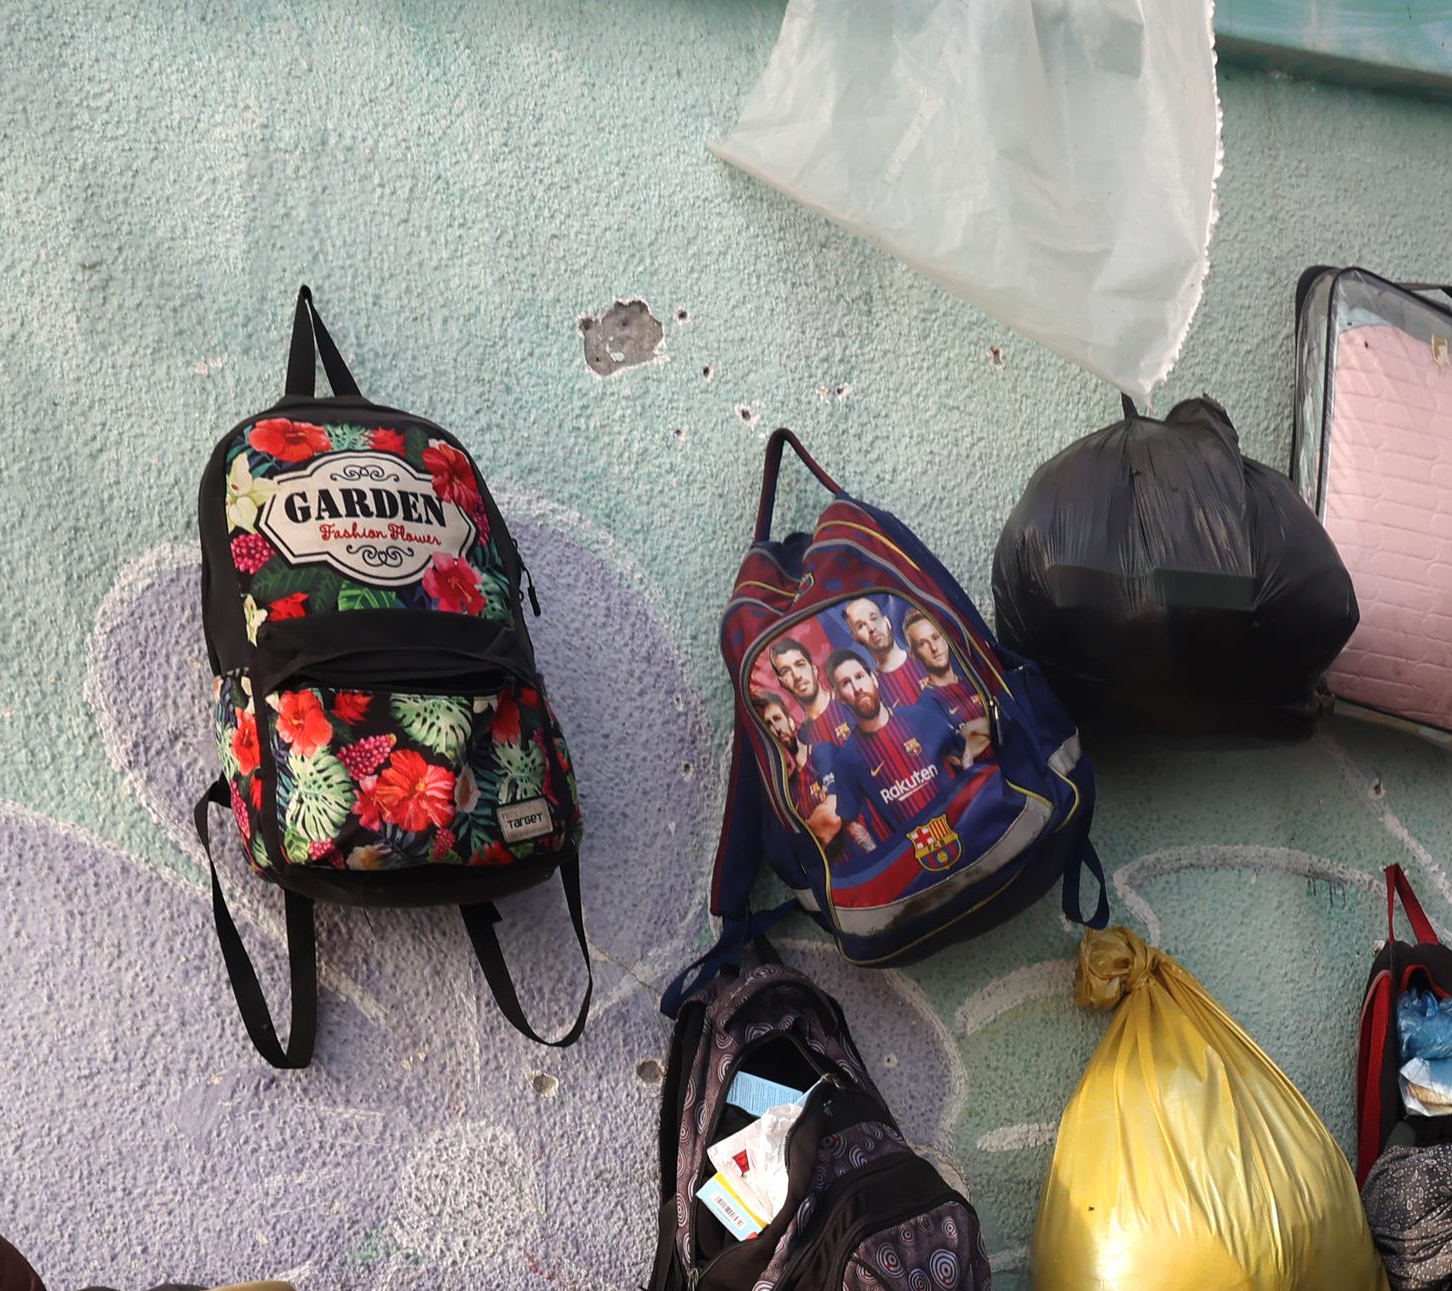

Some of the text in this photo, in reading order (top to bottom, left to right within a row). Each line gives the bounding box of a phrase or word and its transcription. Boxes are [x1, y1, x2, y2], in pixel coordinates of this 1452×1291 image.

[284, 487, 447, 528] GARDEN
[319, 521, 442, 546] Fashion Flower
[879, 762, 939, 805] Rakuten
